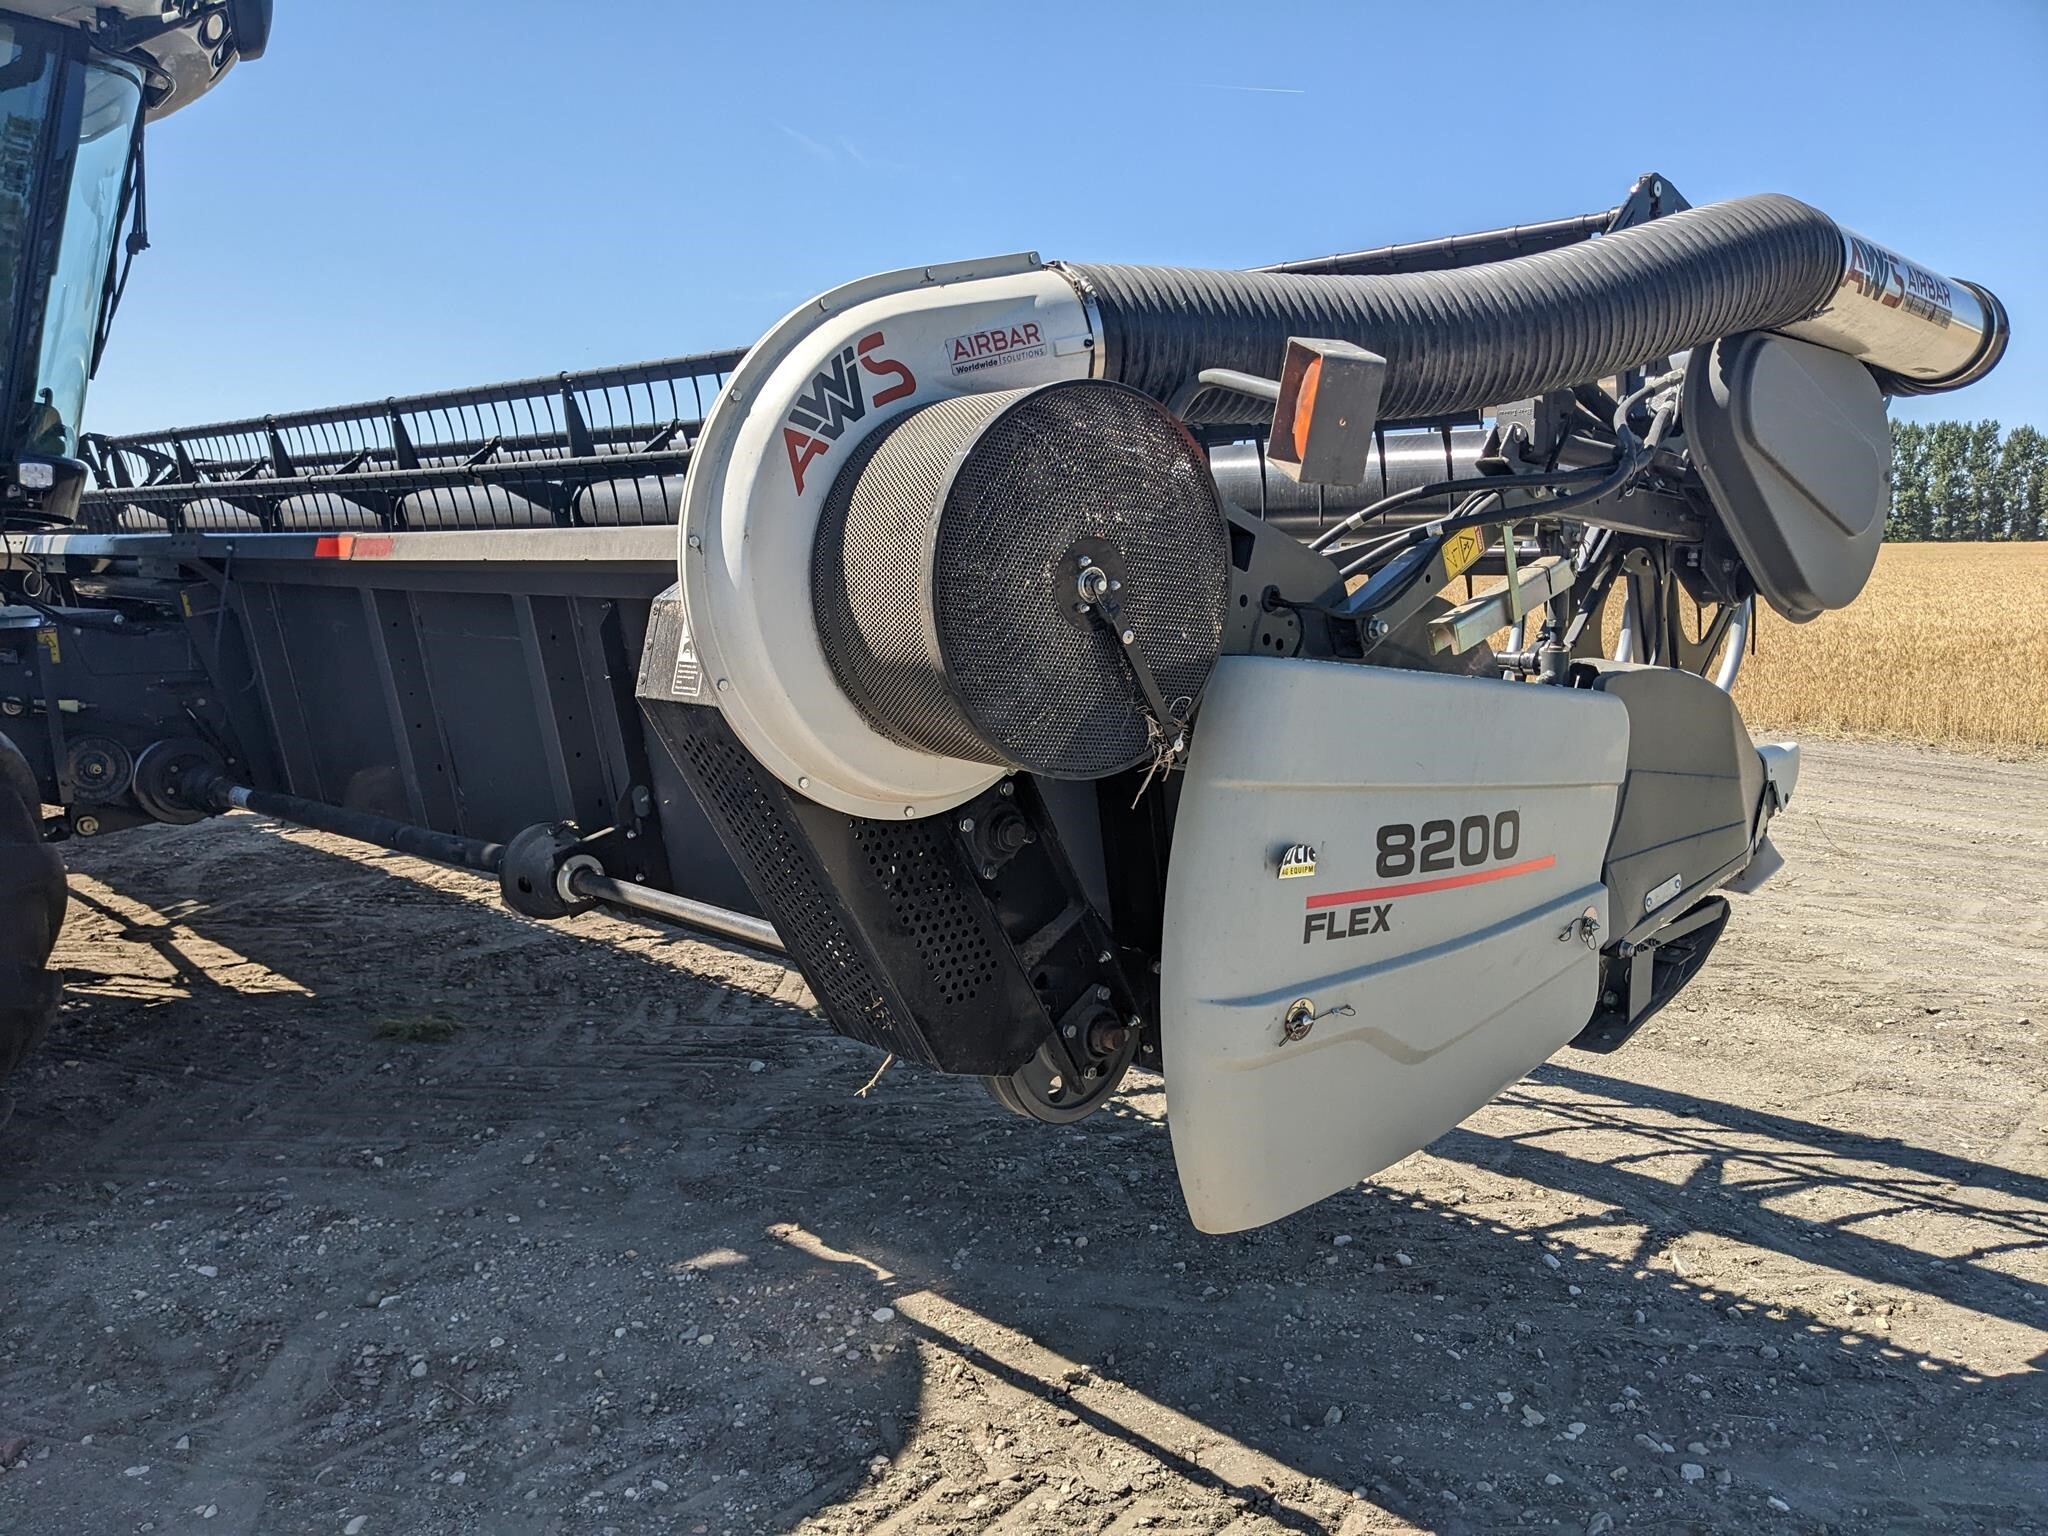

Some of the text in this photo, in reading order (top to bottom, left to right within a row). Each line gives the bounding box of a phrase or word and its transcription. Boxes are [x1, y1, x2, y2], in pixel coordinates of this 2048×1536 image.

[1906, 265, 1952, 308] AIRBAR
[953, 323, 1041, 361] AIRBAR
[956, 348, 1045, 374] Worldwide SOLUTIONS
[1376, 809, 1520, 878] 8200
[1303, 903, 1393, 944] FLEX
